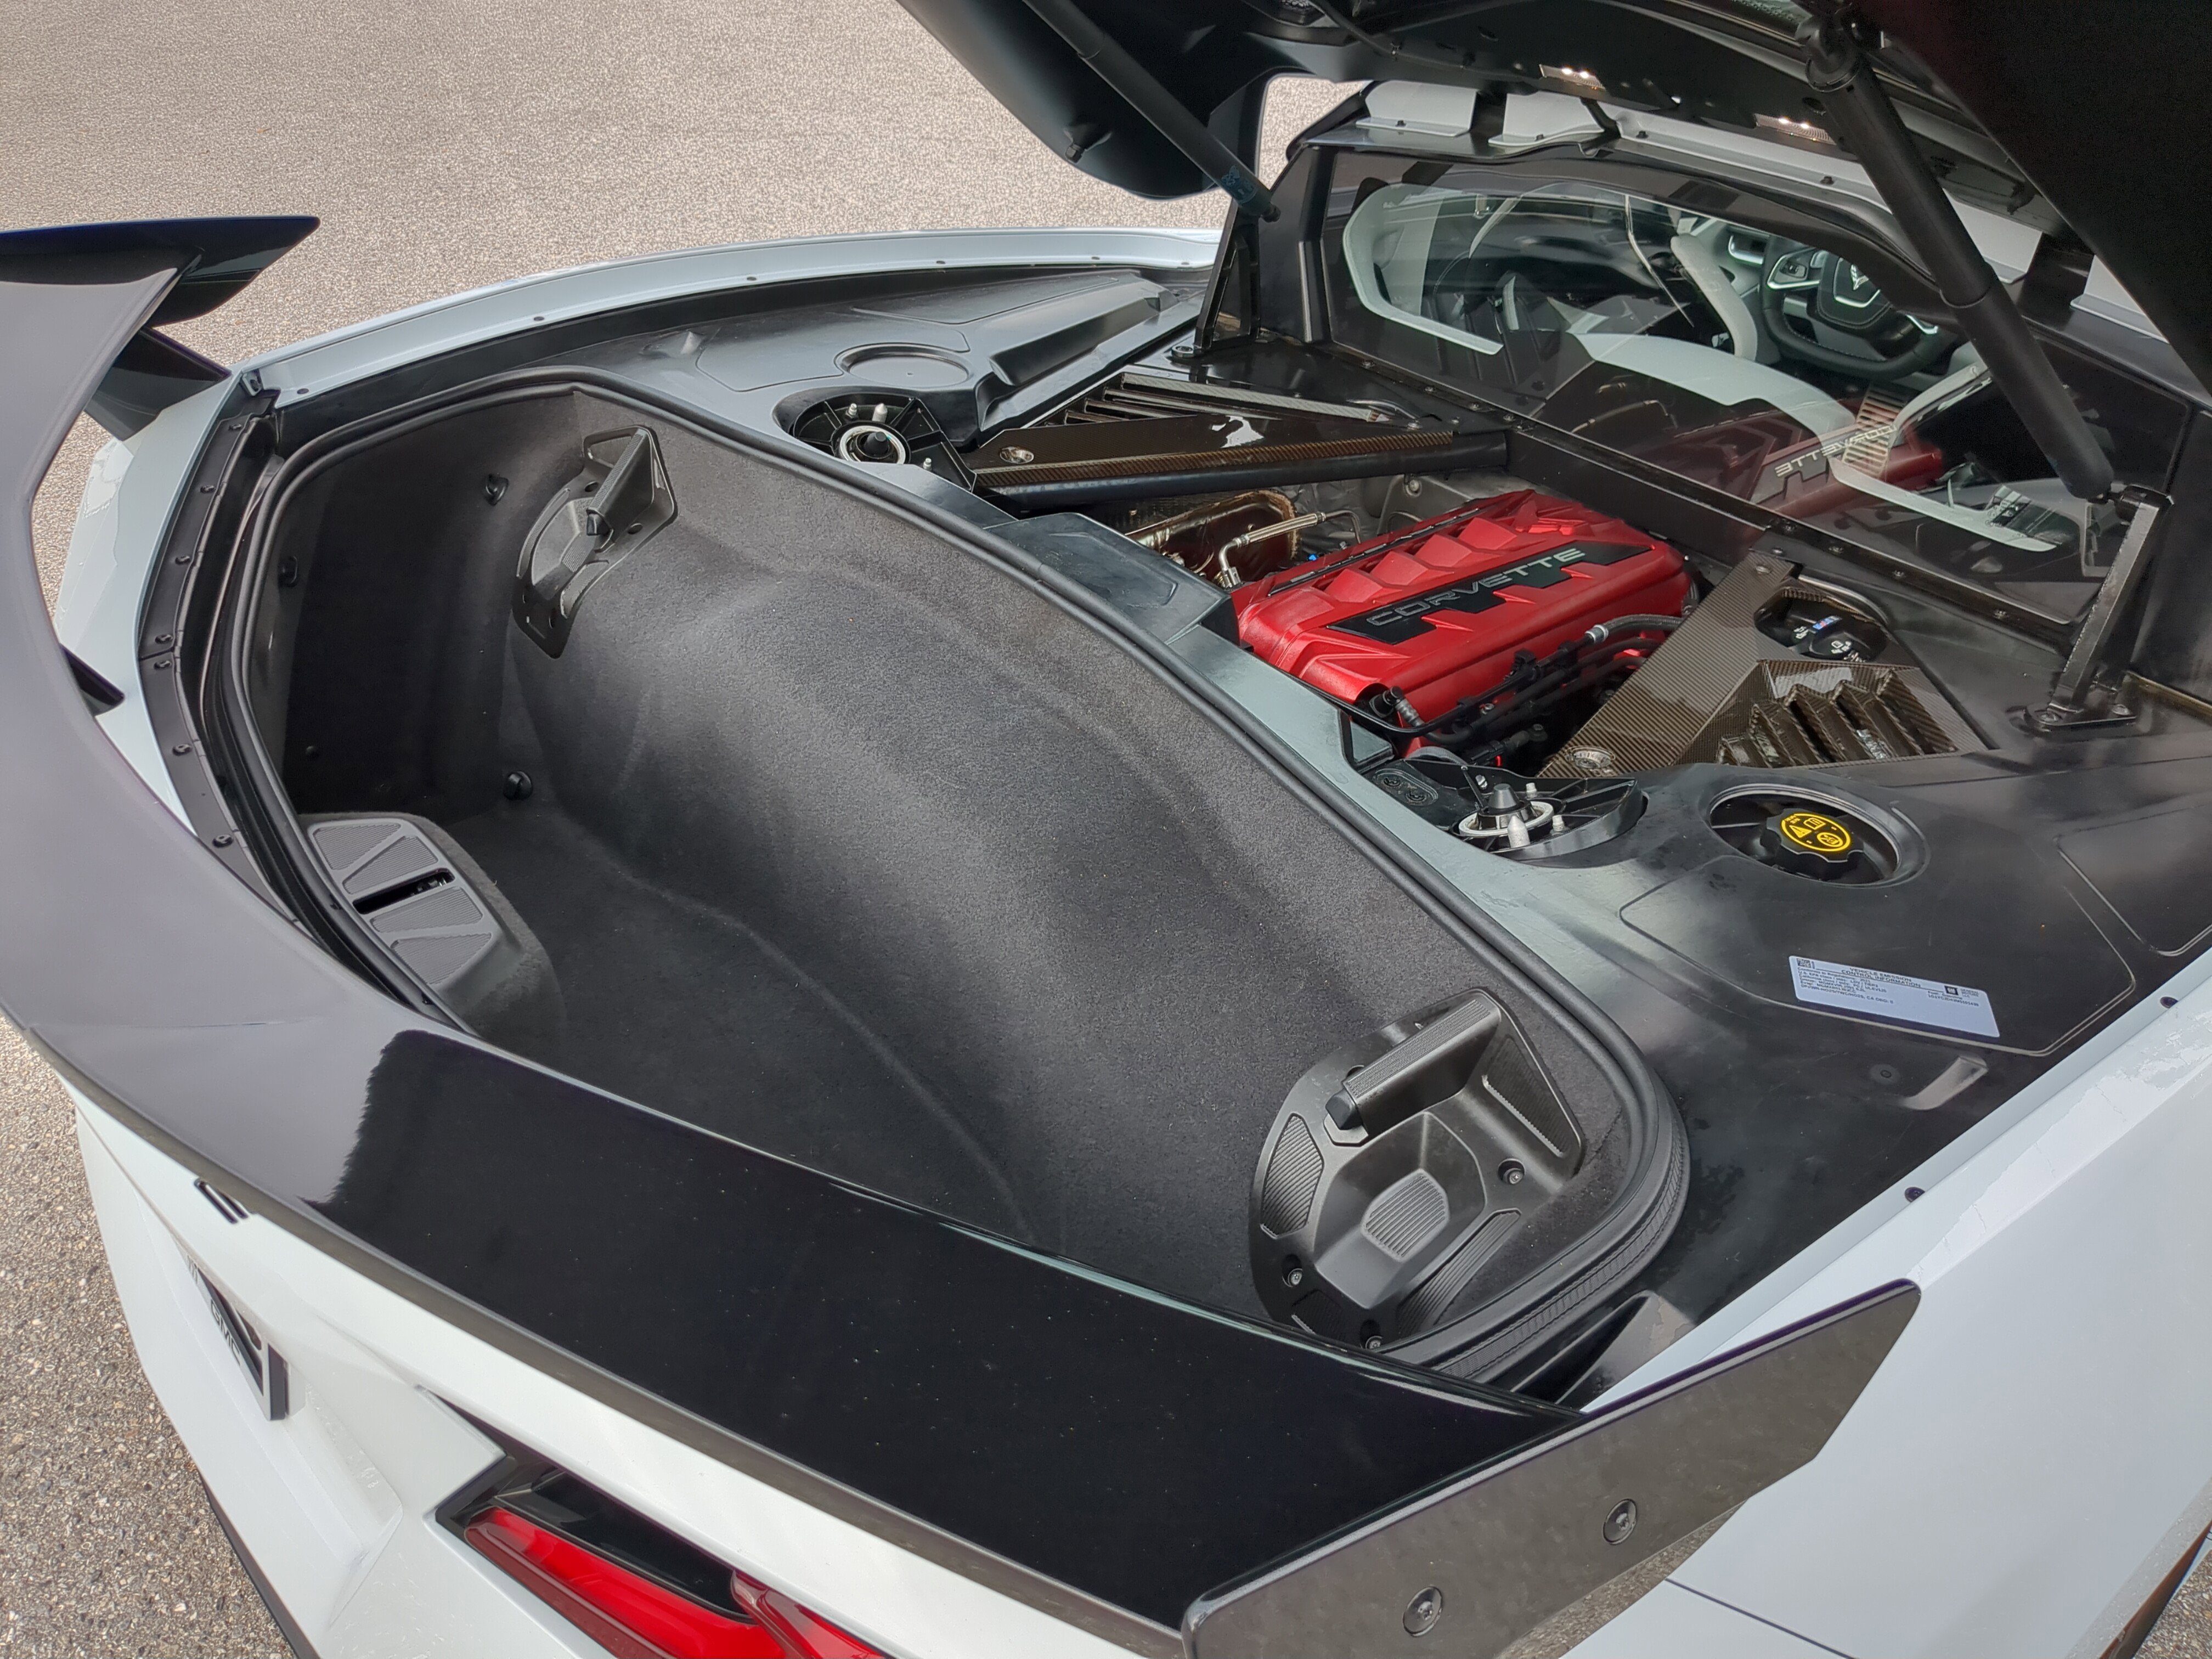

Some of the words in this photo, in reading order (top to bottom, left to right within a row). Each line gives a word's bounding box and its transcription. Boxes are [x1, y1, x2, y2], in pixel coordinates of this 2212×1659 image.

[1366, 548, 1585, 626] CORVETTE
[1841, 969, 1873, 979] CONTROL
[1874, 975, 1921, 988] INFORMATION
[1849, 967, 1878, 976] VEHICLE
[1879, 972, 1911, 982] EMISSION
[210, 1298, 241, 1367] GMC
